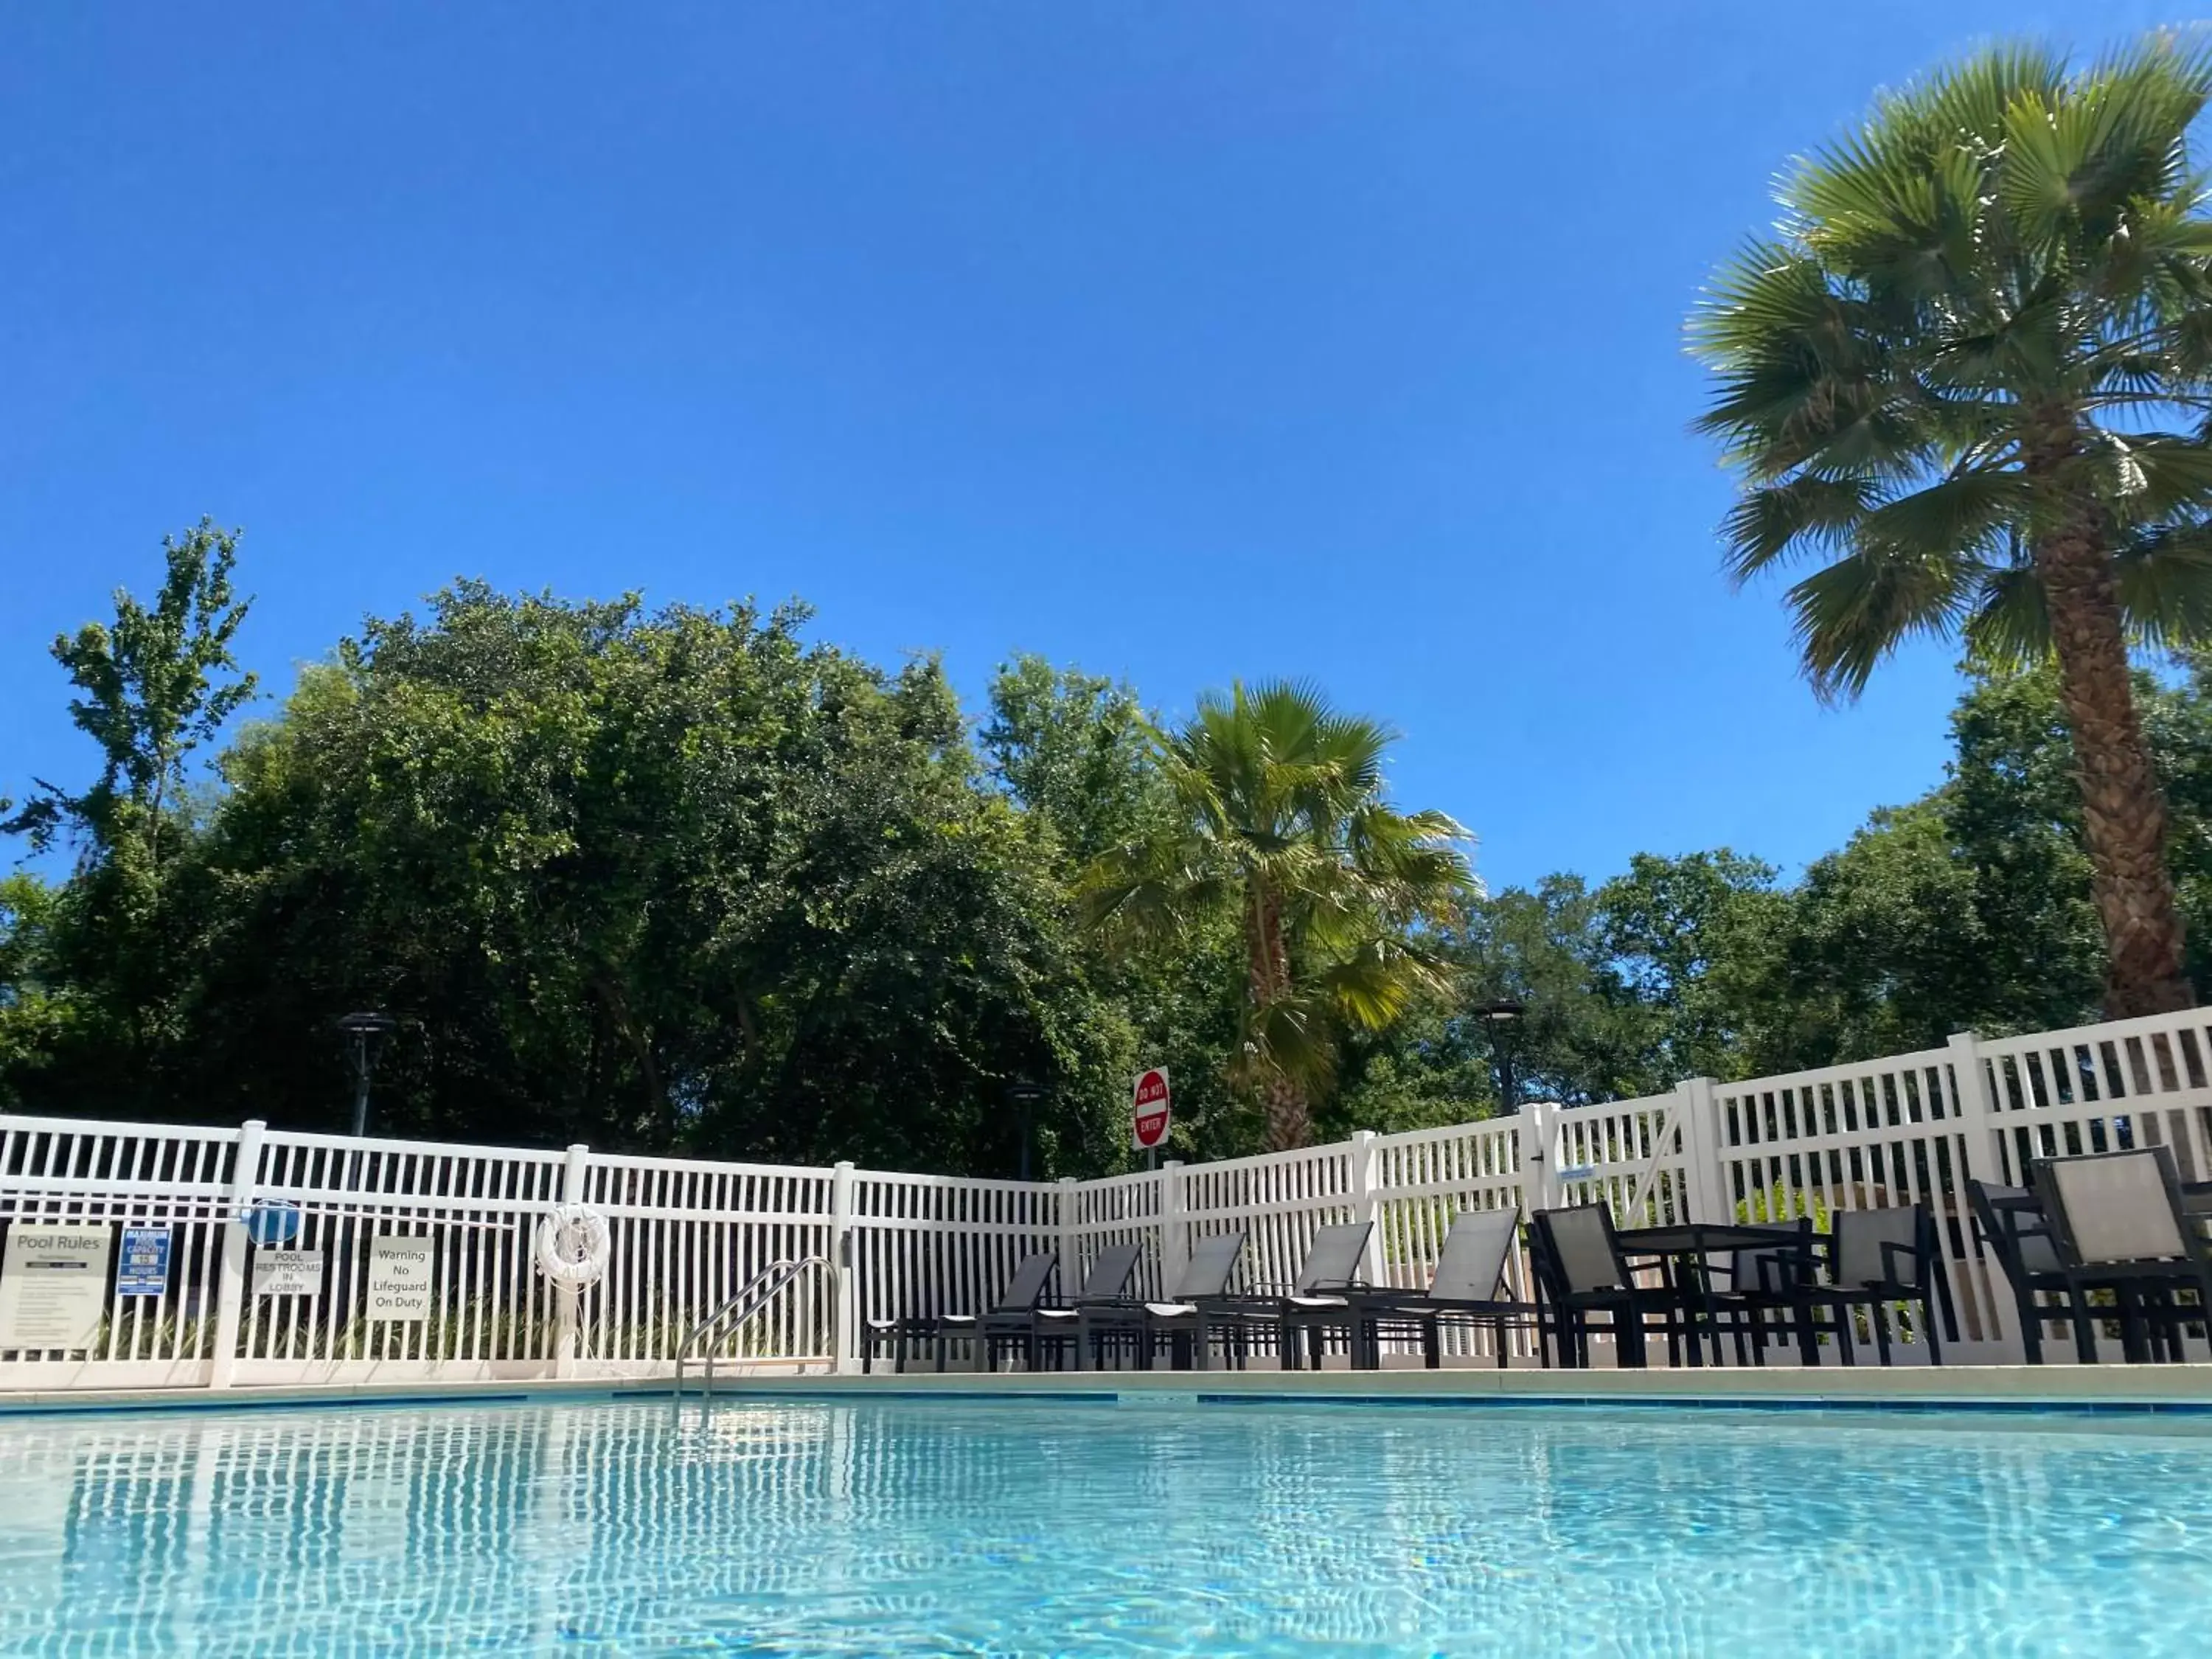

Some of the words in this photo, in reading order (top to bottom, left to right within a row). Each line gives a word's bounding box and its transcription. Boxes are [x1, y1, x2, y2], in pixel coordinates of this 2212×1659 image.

[1139, 1088, 1149, 1100] DO
[1151, 1083, 1163, 1096] NOT
[1141, 1118, 1161, 1133] ENTER
[18, 1235, 53, 1248] Pool
[58, 1235, 101, 1249] Rules
[275, 1253, 303, 1261] POOL
[379, 1250, 425, 1262] Warning
[256, 1263, 320, 1272] RESTROOMS
[393, 1265, 409, 1275] No
[282, 1273, 293, 1281] IN
[374, 1280, 427, 1294] Lifeguard
[375, 1297, 392, 1307] On
[395, 1297, 422, 1310] Duty
